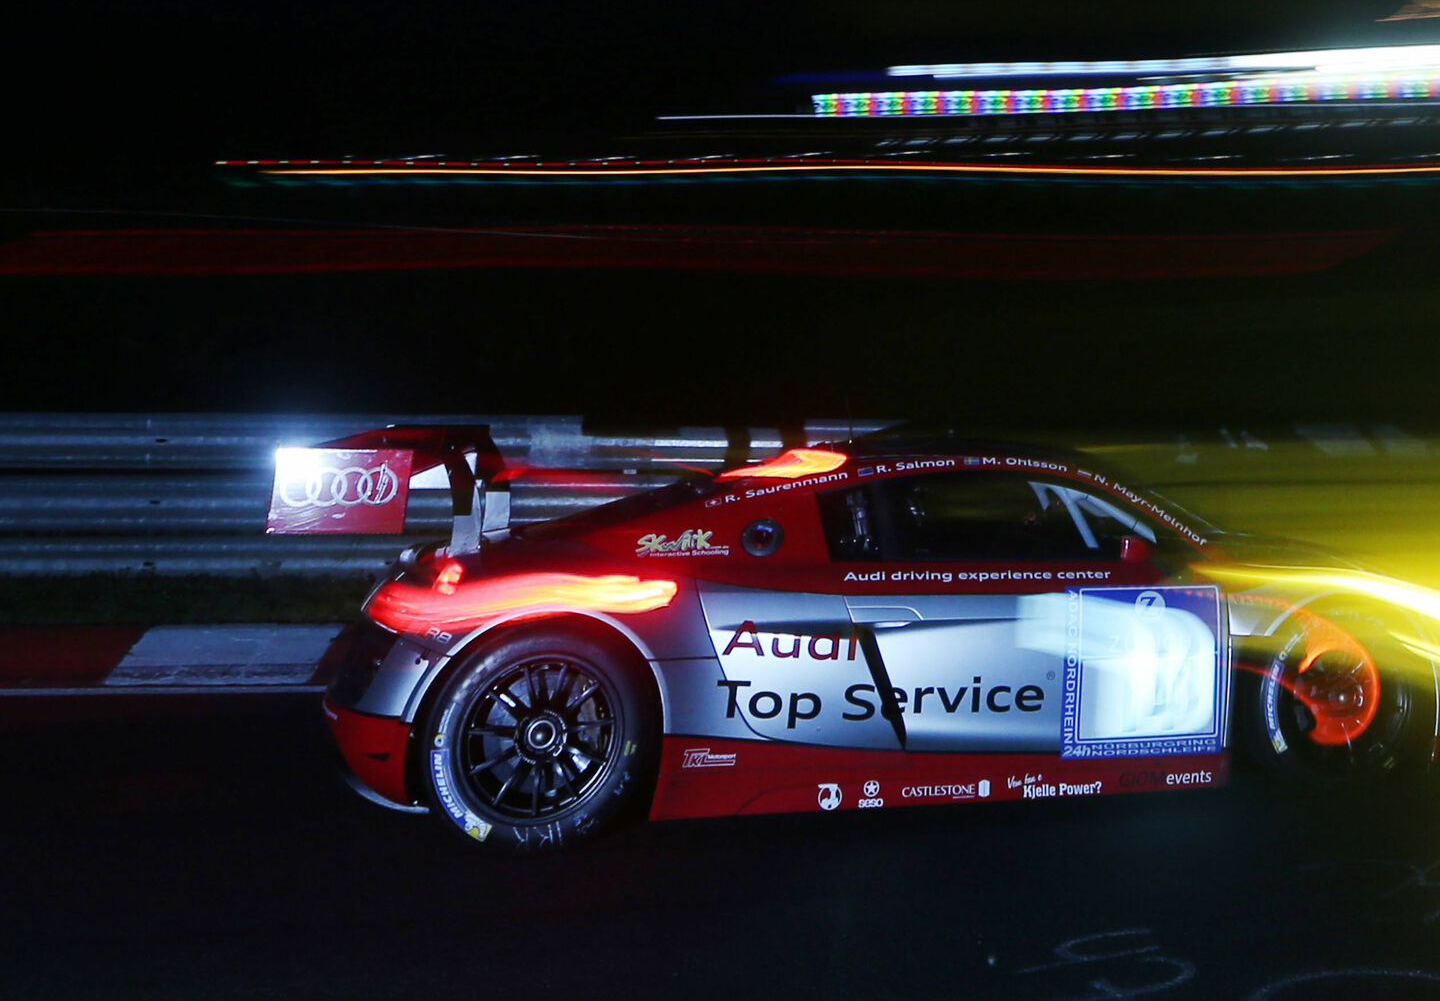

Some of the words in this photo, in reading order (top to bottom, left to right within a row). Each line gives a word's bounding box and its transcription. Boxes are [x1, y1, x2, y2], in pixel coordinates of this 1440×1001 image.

[876, 464, 893, 474] R.
[896, 459, 955, 472] Salmon
[981, 456, 1001, 466] M.
[1006, 457, 1068, 473] Ohlsson
[725, 493, 741, 503] R.
[745, 472, 848, 499] Saurenmann
[1094, 474, 1109, 487] N.
[844, 570, 886, 582] Audi
[890, 570, 952, 584] driving
[958, 571, 1051, 583] experience
[1056, 570, 1111, 581] center
[423, 626, 453, 645] R8
[722, 620, 857, 661] Audi
[717, 680, 822, 729] Top
[842, 676, 1045, 722] Service
[1063, 644, 1078, 744] NORDRHEIN
[1063, 745, 1092, 757] 24h
[1092, 746, 1217, 757] NORDSCHLEIFE
[1166, 769, 1212, 785] events
[434, 753, 464, 820] MICHELIN
[901, 783, 976, 798] CASTLESTONE
[1023, 783, 1056, 800] Kjelle
[1059, 781, 1102, 796] Power?
